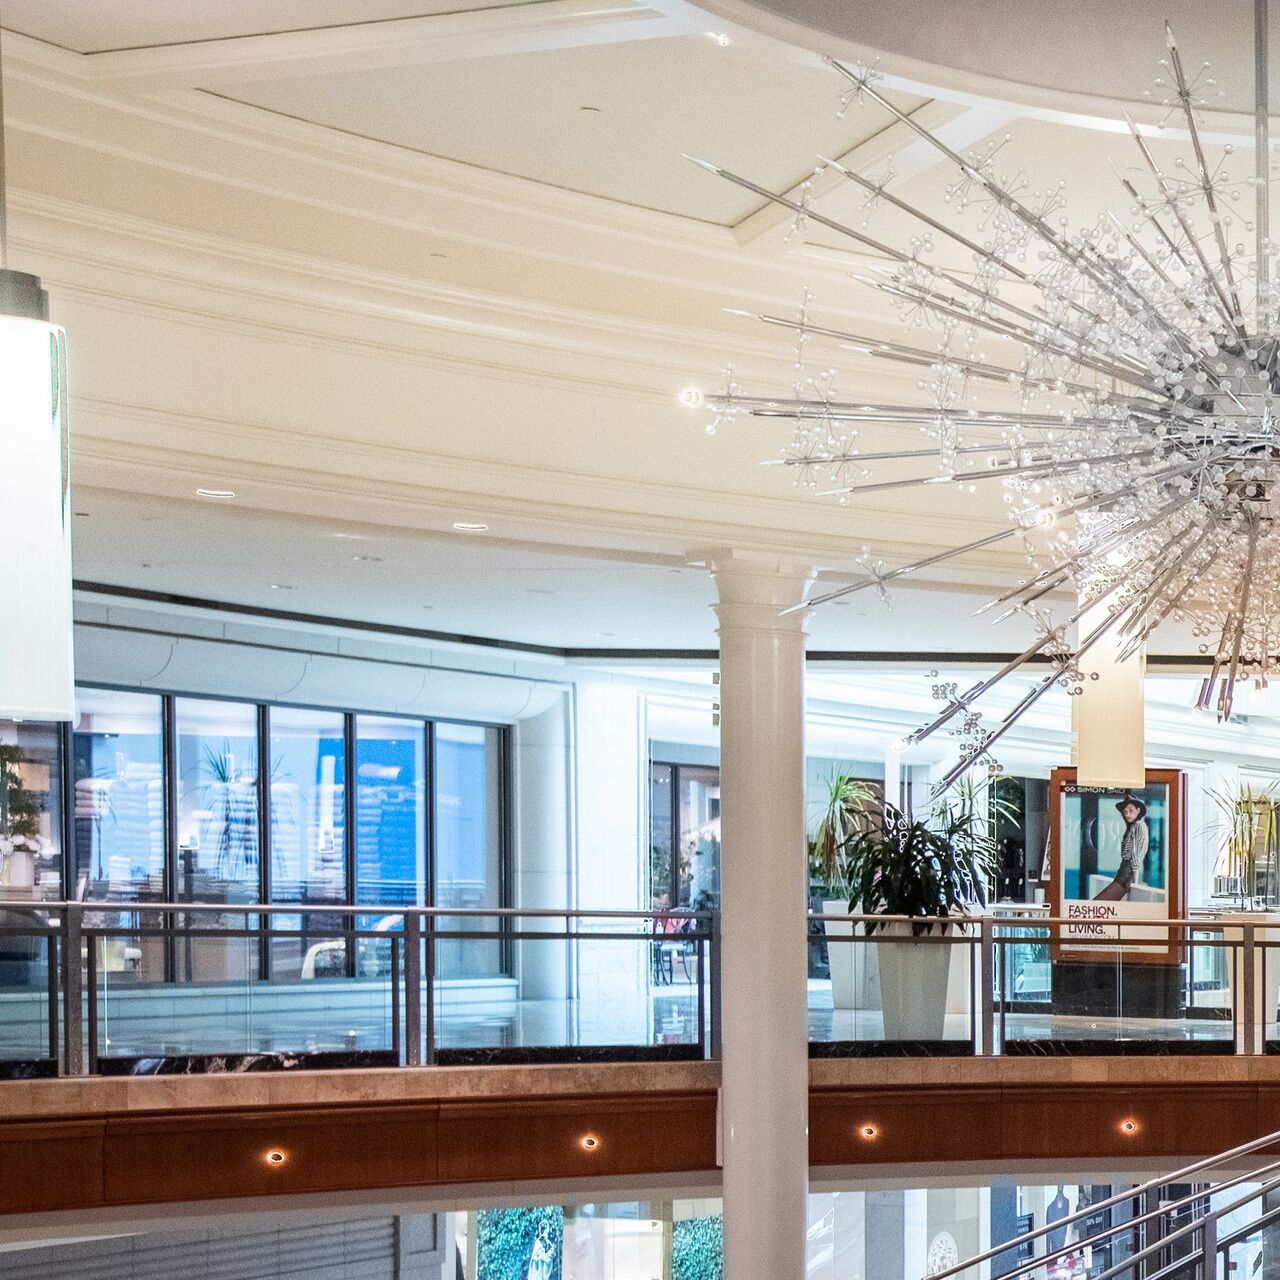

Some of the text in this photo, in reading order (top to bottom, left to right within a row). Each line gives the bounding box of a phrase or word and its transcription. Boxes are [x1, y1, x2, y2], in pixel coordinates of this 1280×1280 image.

[1077, 786, 1105, 794] SIMON
[1068, 904, 1118, 916] FASHION.
[1068, 924, 1106, 935] LIVING.
